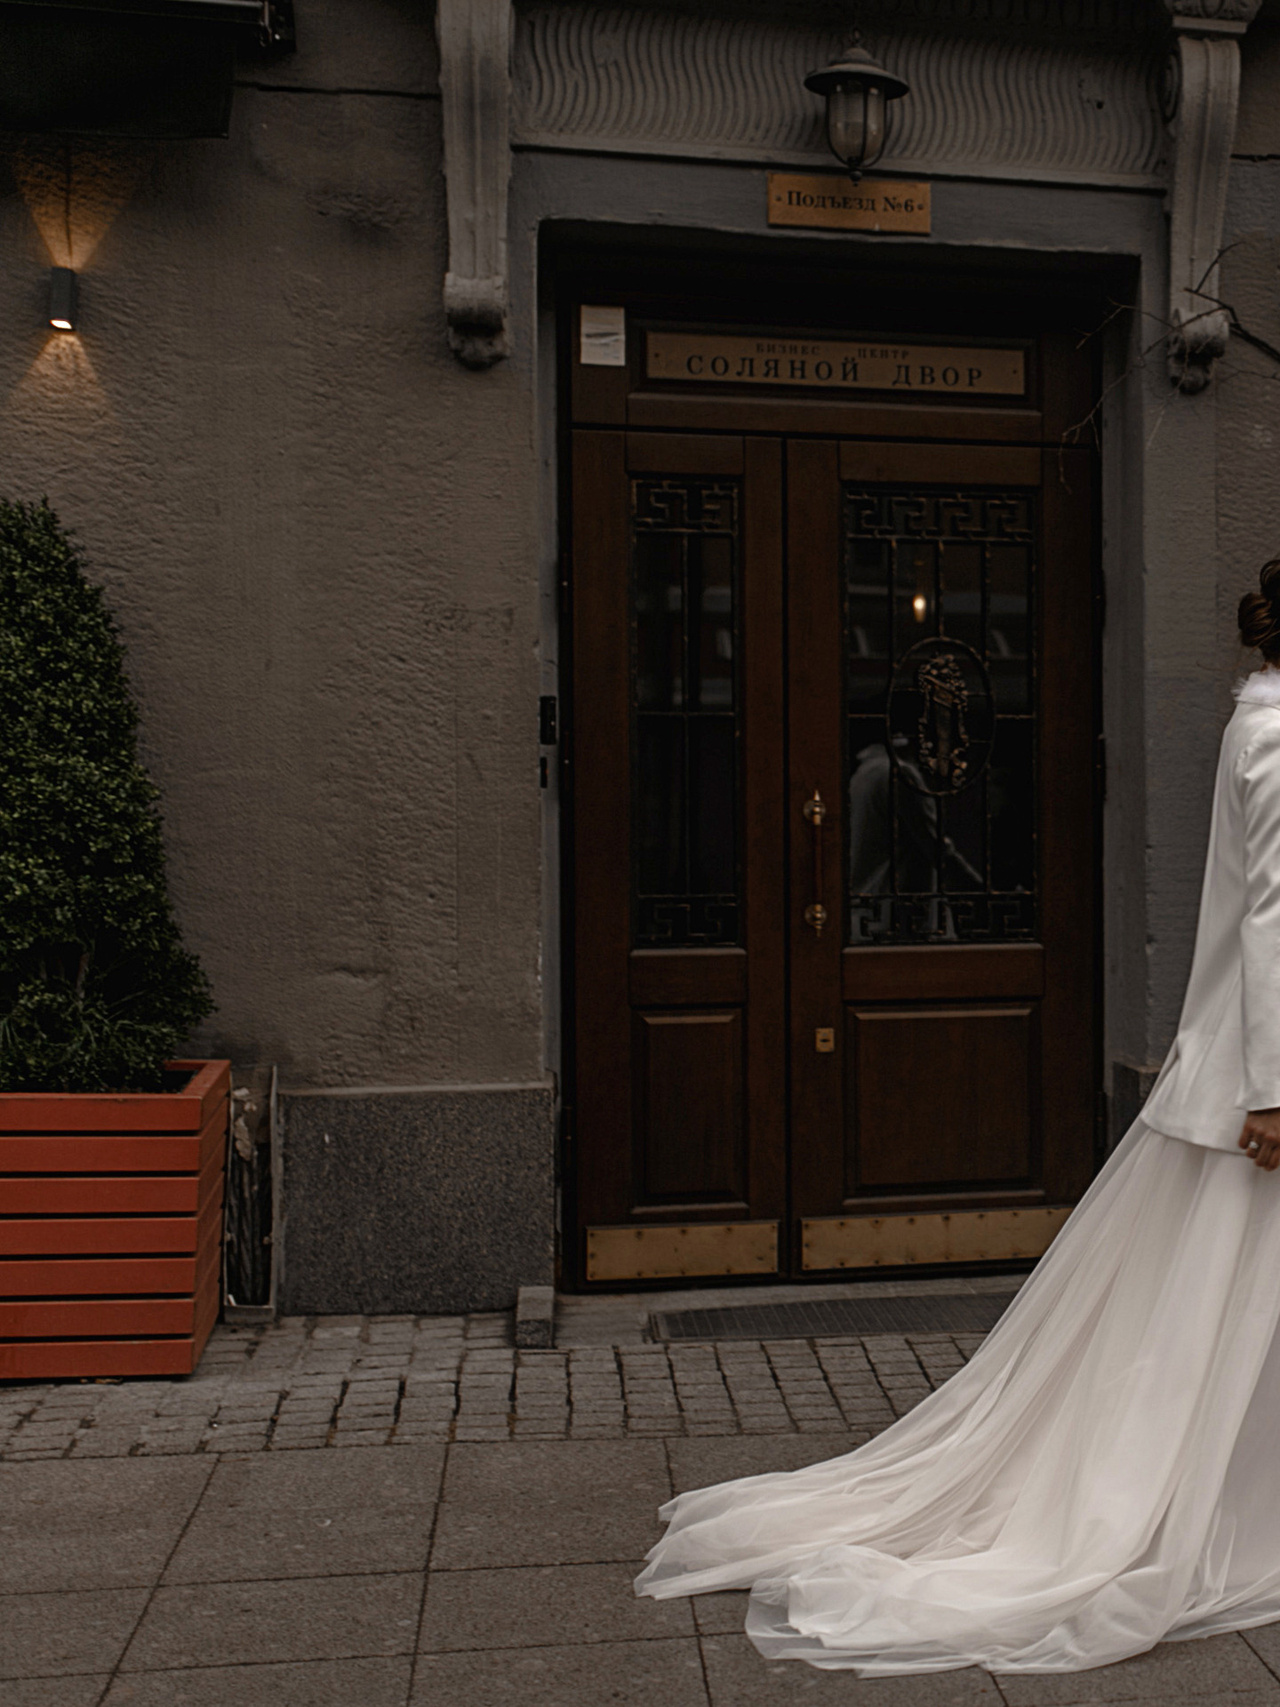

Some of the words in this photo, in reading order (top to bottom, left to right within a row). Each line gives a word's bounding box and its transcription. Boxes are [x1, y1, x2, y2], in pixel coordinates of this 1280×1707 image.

[756, 343, 820, 355] БИЗНЕС
[687, 355, 858, 381] СОЛЯНОЙ
[892, 364, 982, 386] ДВОР
